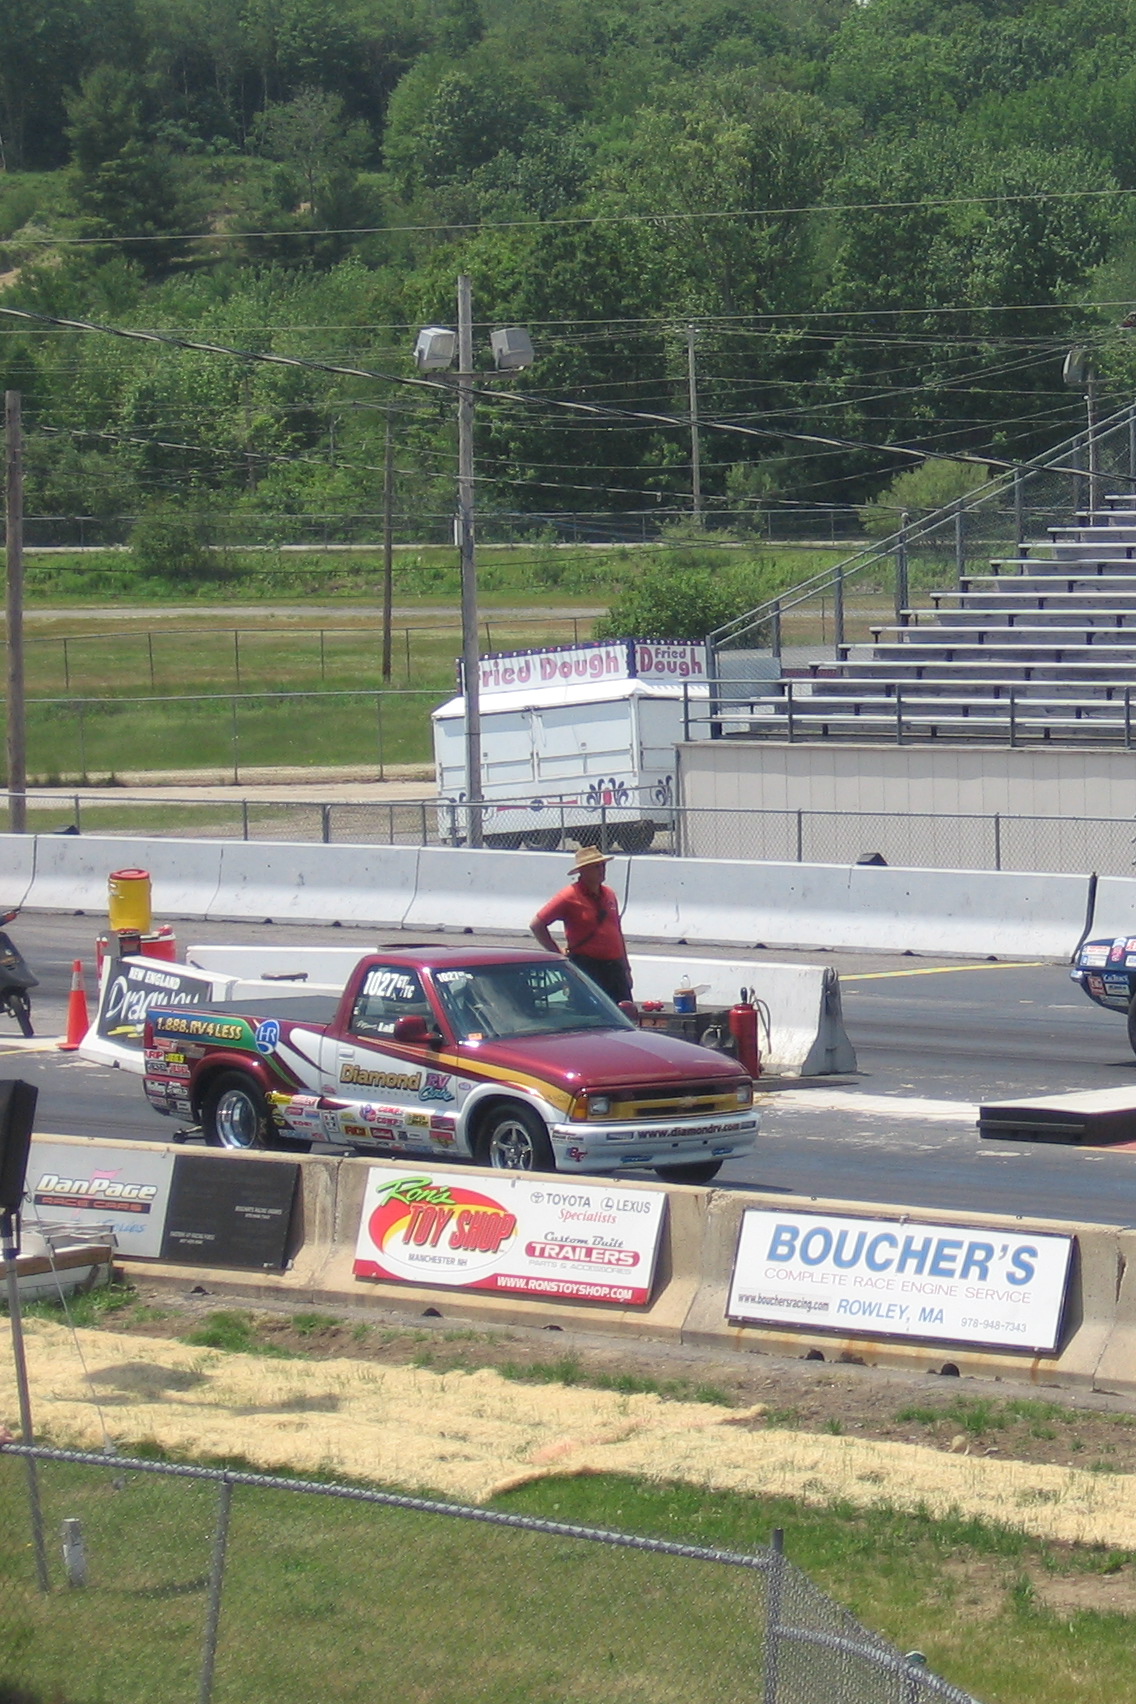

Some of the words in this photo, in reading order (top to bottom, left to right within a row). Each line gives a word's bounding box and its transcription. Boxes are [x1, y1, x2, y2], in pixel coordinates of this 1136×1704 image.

[640, 646, 703, 677] Dough
[654, 646, 686, 659] Fried
[479, 659, 532, 688] ried
[540, 651, 620, 681] Dough
[128, 966, 146, 981] NEW
[145, 970, 181, 991] ENGLAND
[363, 971, 400, 997] 1027
[339, 1063, 422, 1091] Diamond
[424, 1073, 452, 1089] RV
[638, 1122, 740, 1138] www.diamondrv.com
[376, 1176, 457, 1207] Ron's
[545, 1192, 591, 1208] TOYOTA
[615, 1199, 652, 1214] LEXUS
[41, 1196, 89, 1208] RACE
[92, 1200, 143, 1212] CARS
[402, 1203, 454, 1248] TOY
[448, 1209, 517, 1254] SHOP
[559, 1208, 618, 1225] Specialists
[543, 1231, 590, 1246] Custom
[592, 1235, 624, 1249] Built
[408, 1253, 456, 1266] MANCHESTER
[531, 1243, 635, 1265] TRAILERS
[766, 1223, 1039, 1286] BOUCHER'S
[496, 1276, 633, 1300] WWW.RONSTOYSHOP.COM
[764, 1267, 848, 1286] COMPLETE
[853, 1276, 896, 1291] RACE
[901, 1280, 959, 1297] ENGINE
[964, 1287, 1032, 1304] SERVICE
[836, 1298, 911, 1323] ROWLEY,
[918, 1306, 945, 1324] MA
